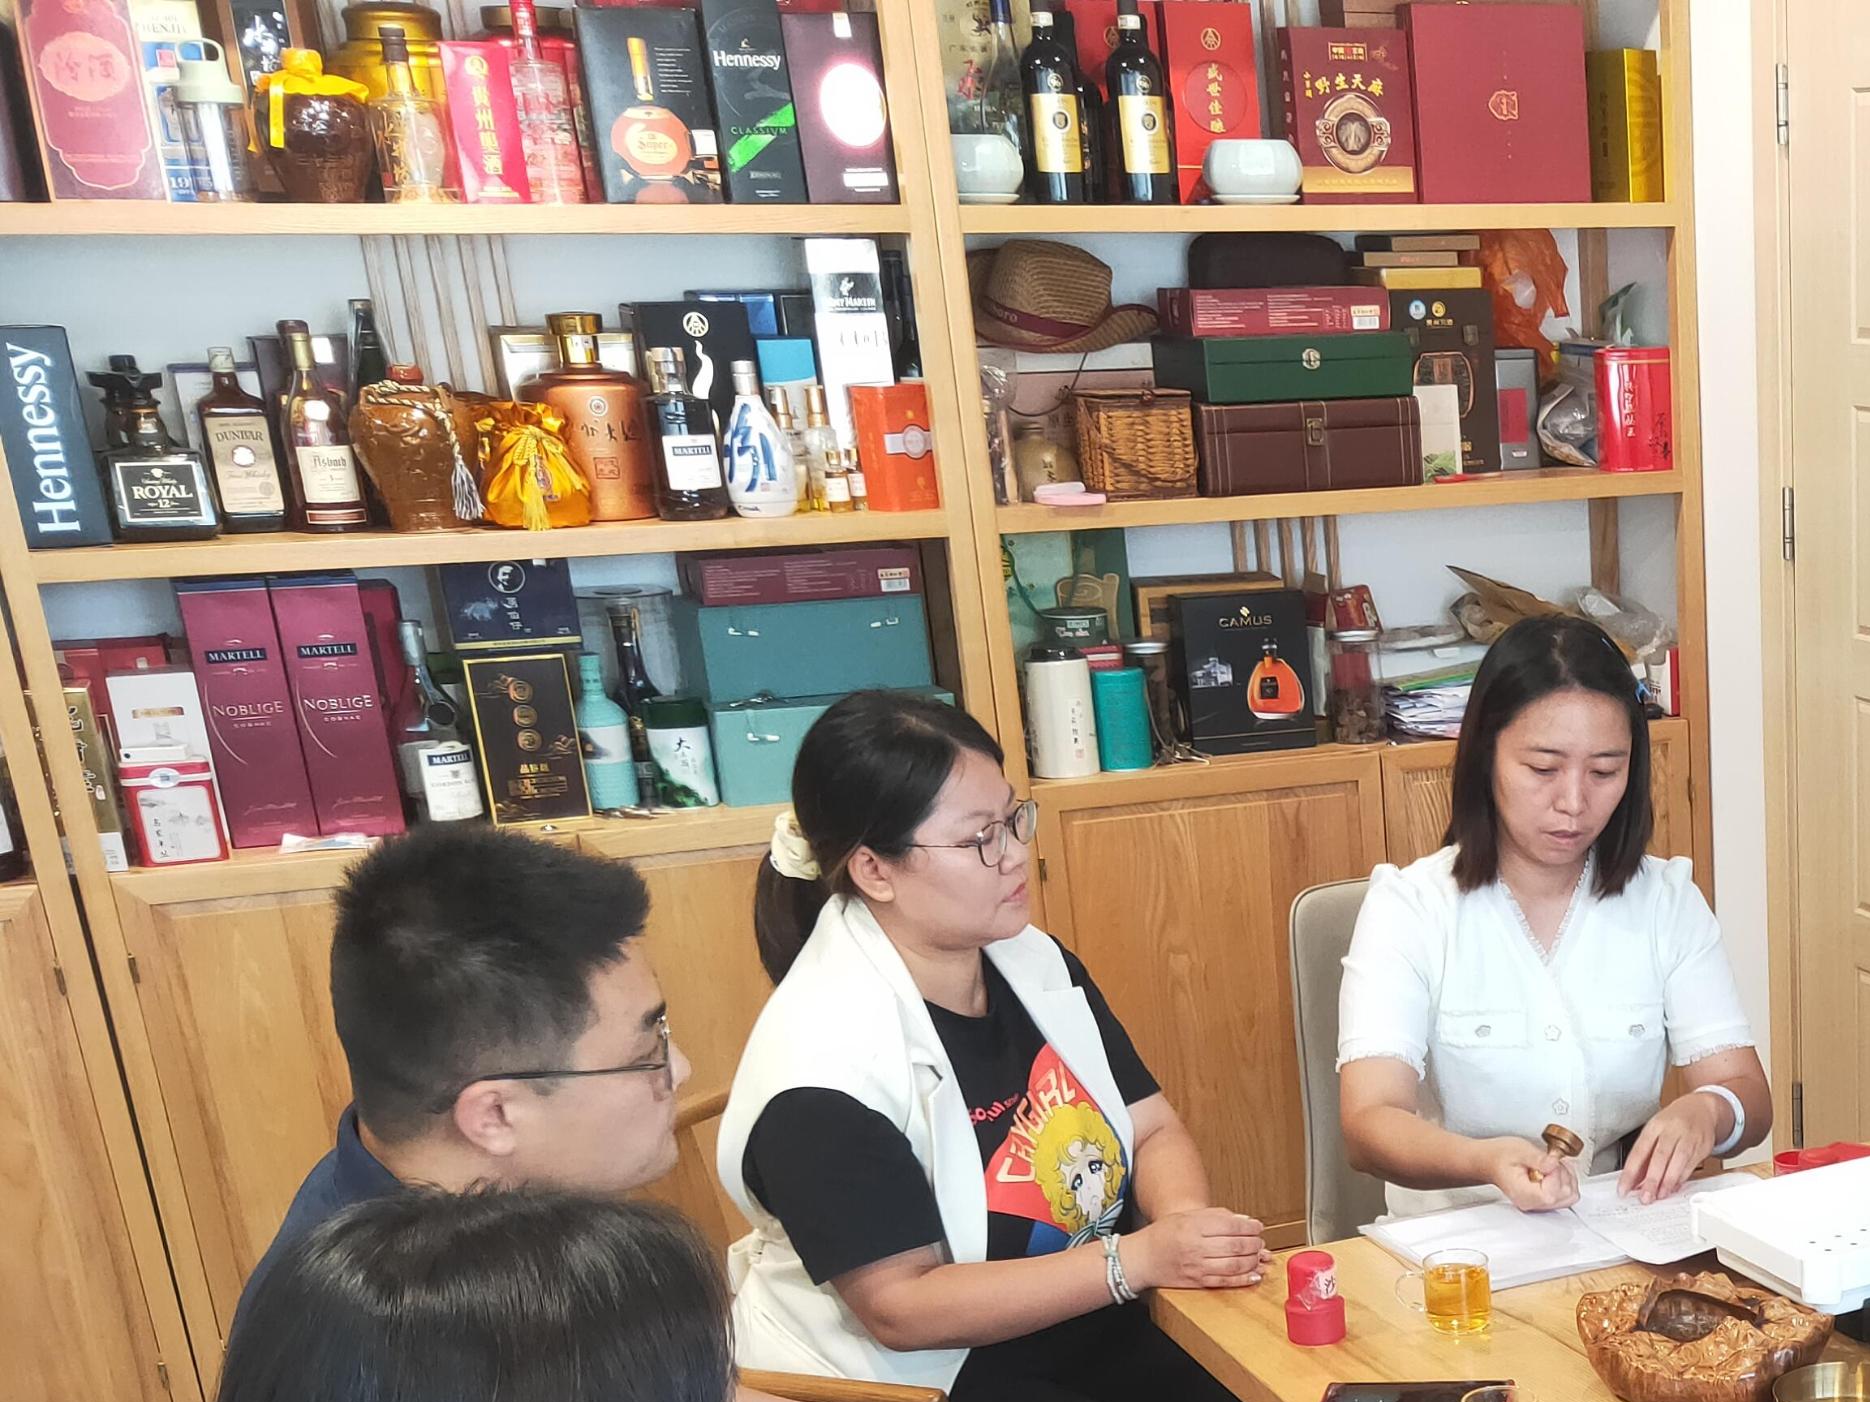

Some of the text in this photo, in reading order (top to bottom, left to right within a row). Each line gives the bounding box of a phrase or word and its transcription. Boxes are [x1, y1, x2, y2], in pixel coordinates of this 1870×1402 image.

[713, 51, 781, 70] Hennessy
[1315, 73, 1384, 97] 野生天麻
[6, 342, 82, 534] Hennessy
[673, 446, 711, 455] MARTELL
[132, 485, 194, 499] ROYAL
[157, 499, 171, 508] 12
[1219, 614, 1273, 628] CAMUS
[208, 650, 265, 662] MARTELL
[300, 645, 353, 656] MARTELL
[212, 700, 285, 717] NOBLIGE
[303, 695, 374, 711] NOBLIGE
[432, 755, 470, 764] MARTELL
